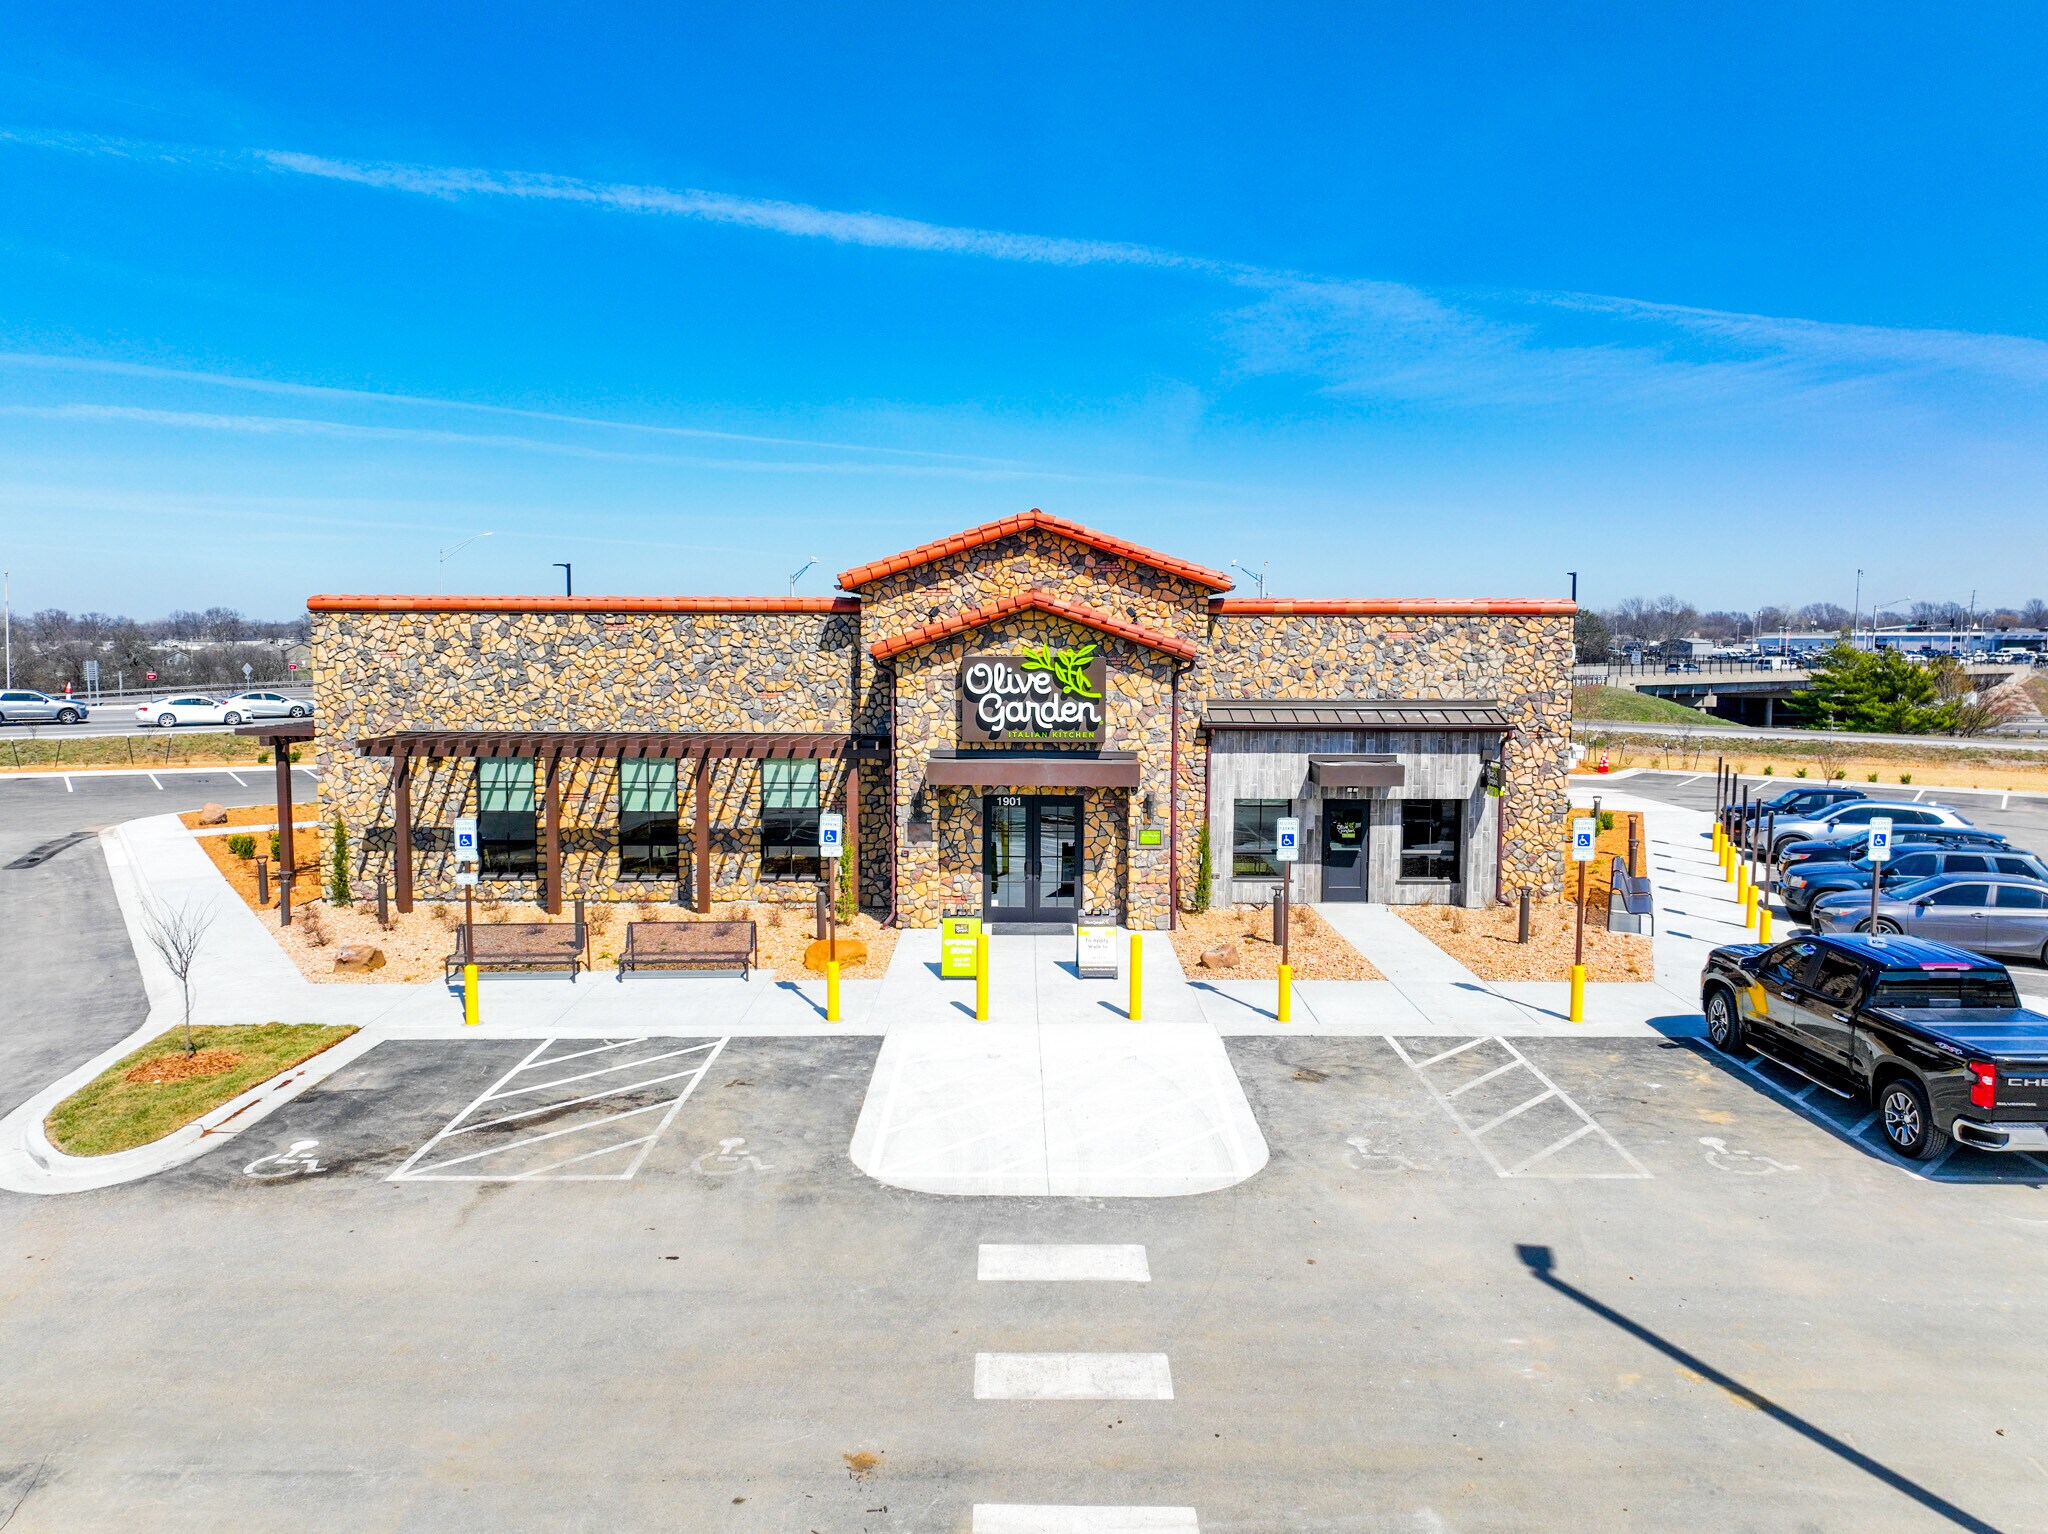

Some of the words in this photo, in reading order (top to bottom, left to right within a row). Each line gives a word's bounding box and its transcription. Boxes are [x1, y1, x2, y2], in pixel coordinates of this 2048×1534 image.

[966, 663, 1051, 695] Olive
[978, 693, 1101, 731] Garden
[997, 797, 1021, 806] 1901
